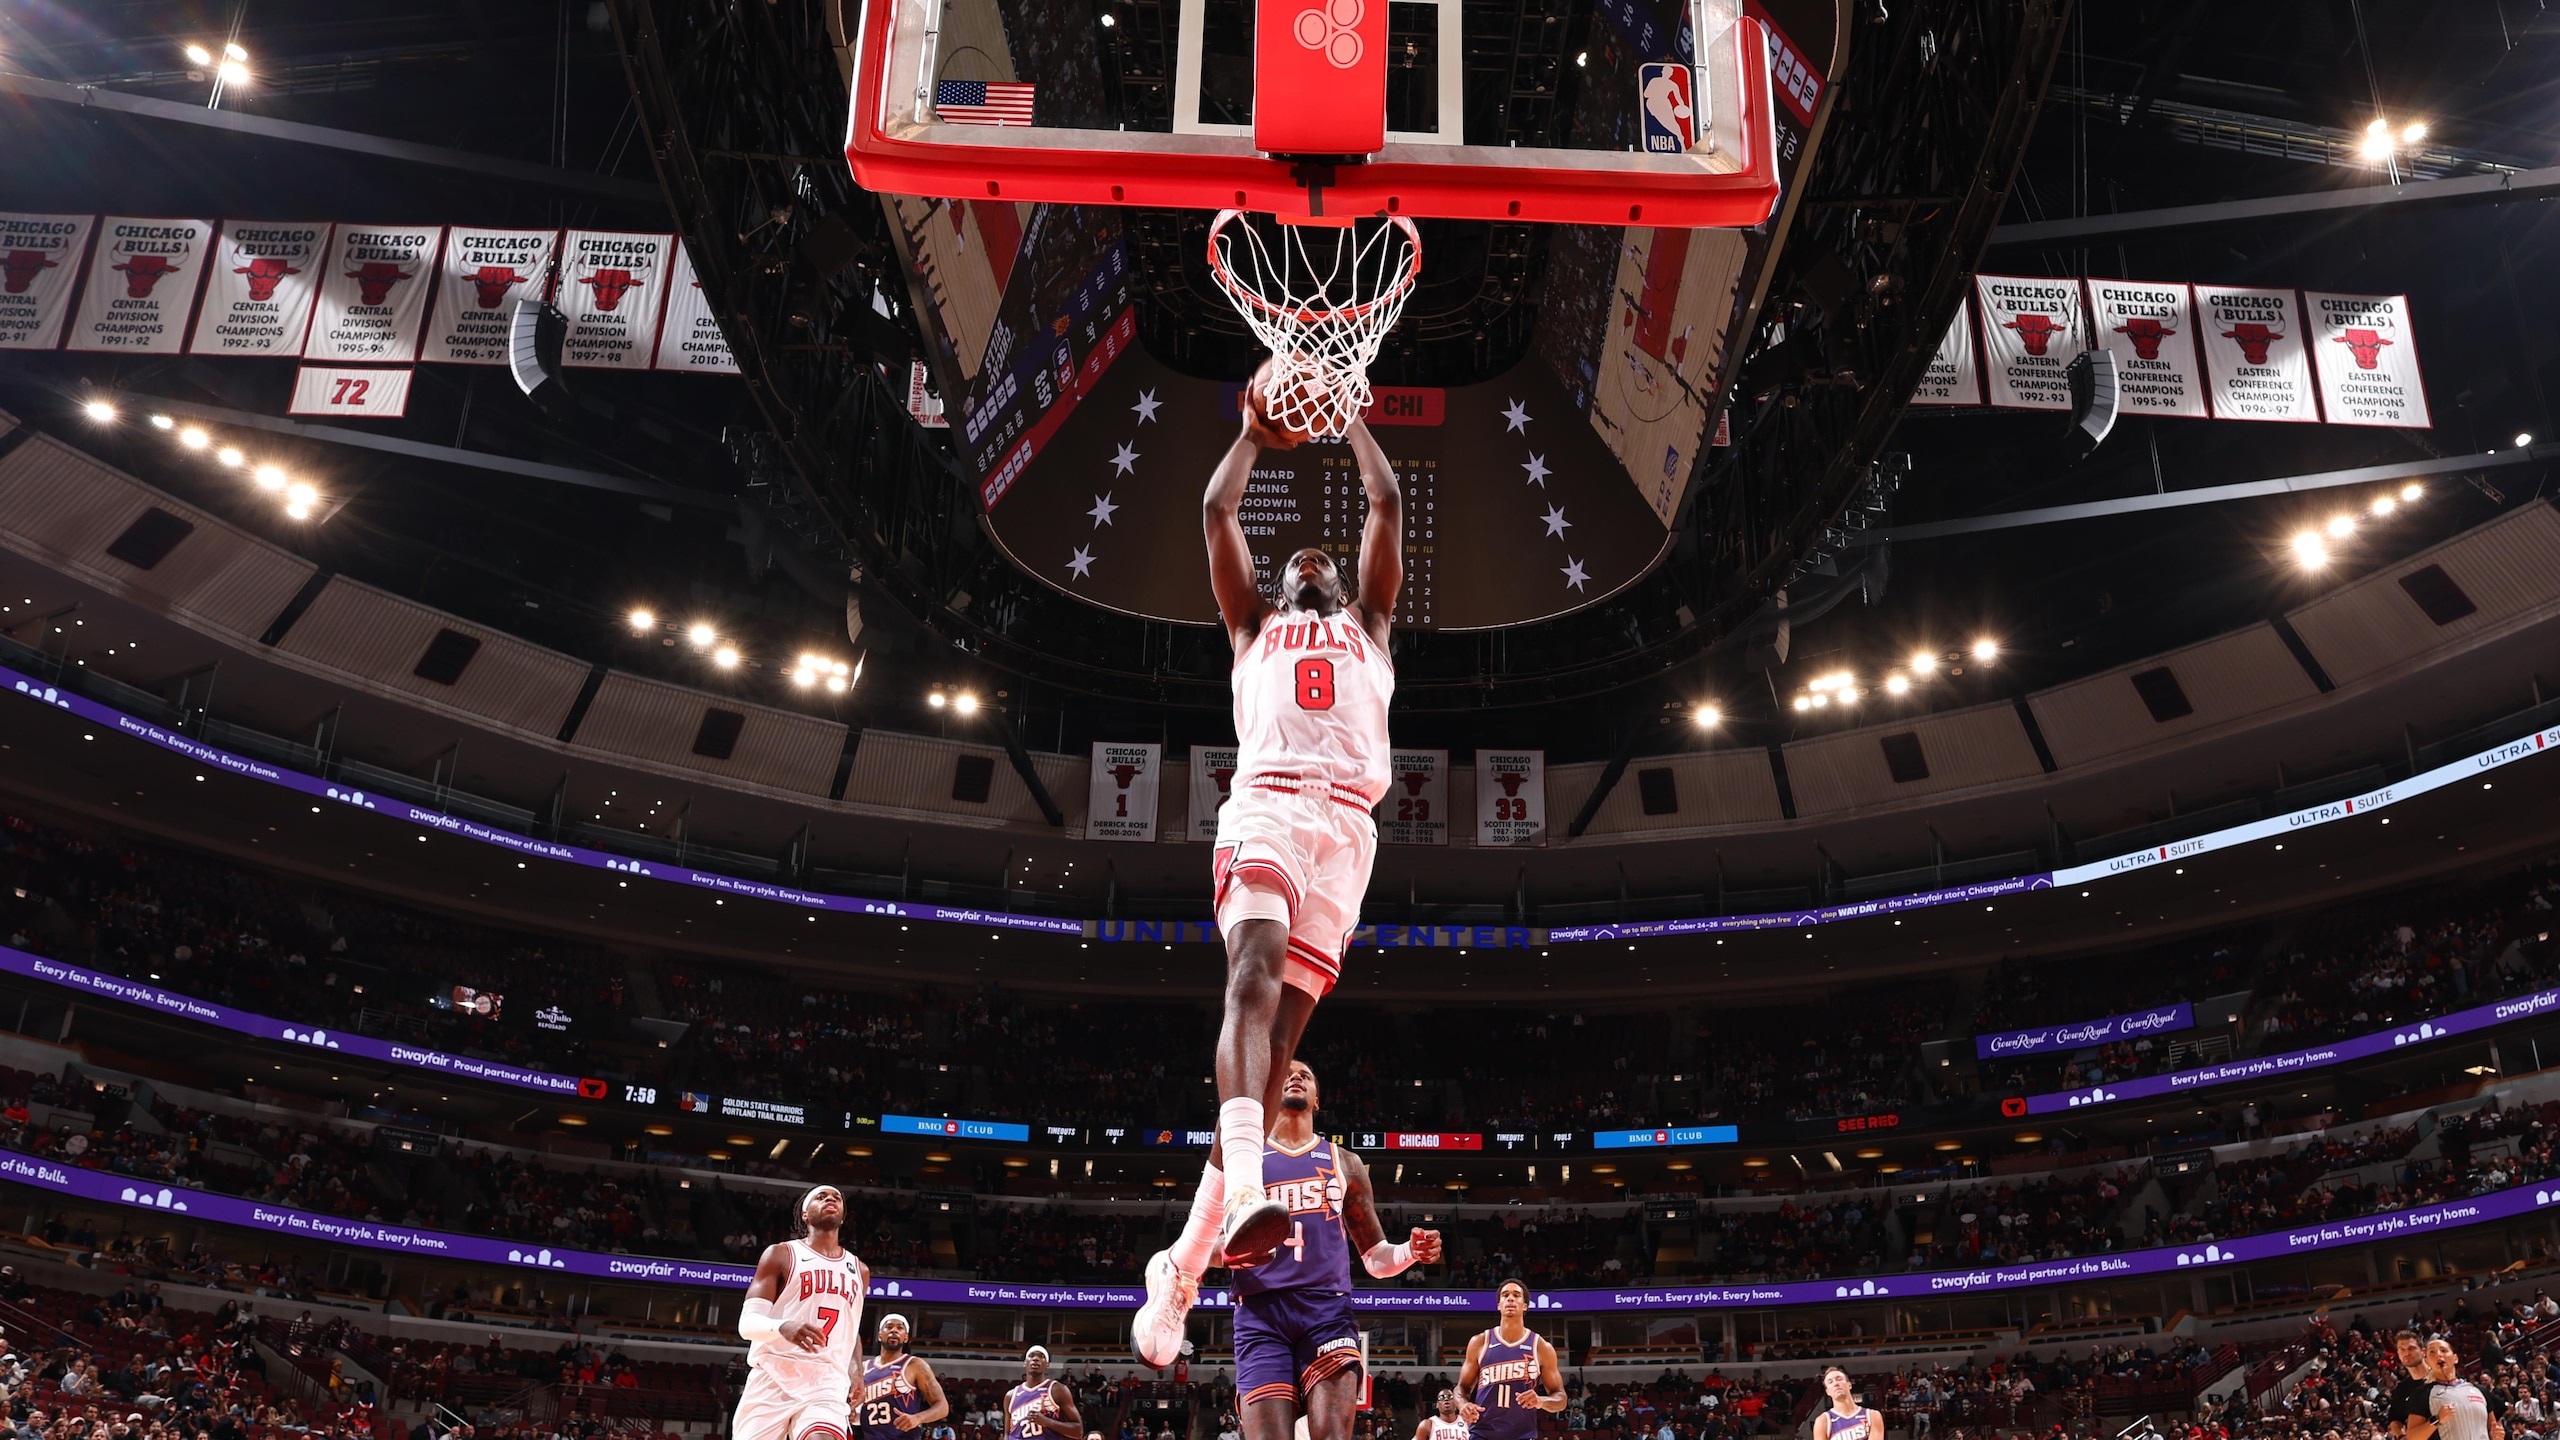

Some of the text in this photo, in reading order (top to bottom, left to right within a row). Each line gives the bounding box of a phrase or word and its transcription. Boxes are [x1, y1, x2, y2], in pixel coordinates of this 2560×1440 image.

[1651, 135, 1676, 151] NBA
[115, 225, 196, 239] CHICAGO
[235, 229, 315, 242] CHICAGO
[123, 240, 181, 253] BULLS
[245, 244, 302, 256] BULLS
[579, 240, 656, 254] CHICAGO
[589, 254, 644, 267] BULLS
[112, 299, 159, 309] CENTRAL
[233, 302, 279, 312] CENTRAL
[2210, 296, 2283, 309] CHICAGO
[2321, 299, 2393, 314] CHICAGO
[106, 312, 158, 321] DIVISION
[228, 314, 278, 324] DIVISION
[580, 314, 626, 324] CENTRAL
[2223, 309, 2275, 321] BULLS
[2334, 314, 2386, 327] BULLS
[94, 323, 163, 334] CHAMPIONS
[216, 325, 283, 336] CHAMPIONS
[575, 326, 626, 336] DIVISION
[566, 338, 632, 350] CHAMPIONS
[2236, 367, 2280, 376] EASTERN
[2349, 373, 2391, 382] EASTERN
[2229, 379, 2293, 390] CONFERENCE
[2341, 384, 2404, 395] CONFERENCE
[331, 379, 370, 405] 72
[2232, 391, 2294, 401] CHAMPIONS
[1384, 395, 1422, 417] CHI
[2343, 397, 2405, 407] CHAMPIONS
[1322, 458, 1334, 466] PTS
[1325, 472, 1331, 480] 2
[1325, 500, 1330, 508] 5
[1342, 500, 1347, 509] 3
[1324, 514, 1330, 522] 8
[1324, 528, 1330, 536] 6
[1261, 621, 1365, 663] BULLS
[1295, 658, 1335, 711] 8
[120, 717, 279, 779] Every fan. Every style. Every home.
[1105, 748, 1147, 756] CHICAGO
[1490, 756, 1531, 764] CHICAGO
[1116, 794, 1128, 817] 1
[1496, 798, 1527, 821] 33
[2290, 791, 2394, 827] ULTRA SUITE
[1093, 820, 1126, 828] DERRICK
[1514, 821, 1539, 829] PIPPEN
[418, 810, 461, 829] wayfair
[464, 824, 490, 838] Proud
[490, 833, 523, 847] partner
[534, 844, 548, 853] the
[550, 847, 573, 858] Bulls.
[1099, 829, 1141, 837] 2008-2016
[1556, 929, 1589, 939] wayfair
[1722, 919, 1758, 929] everything
[1759, 917, 1776, 925] ships
[1838, 906, 1858, 917] WAY
[1859, 903, 1877, 914] DAY
[1888, 900, 1902, 908] the
[1910, 893, 1943, 906] wayfair
[1944, 891, 1966, 899] store
[1968, 879, 2024, 896] Chicagoland
[1099, 920, 1222, 943] UNIT
[33, 961, 219, 1019] Every fan. Every style. Every home.
[400, 1048, 656, 1104] wayfair Proud partner of the Bulls. 7:58
[723, 1098, 803, 1115] GOLDEN STATE WARRIORS
[722, 1106, 804, 1124] PORTLAND TRAIL BLAZERS
[918, 1122, 993, 1134] BMO CLUB
[1047, 1126, 1124, 1137] TIMEOUTS FOULS
[1837, 1118, 1866, 1132] SEE
[1363, 1134, 1440, 1148] 33 CHICAGO
[1554, 1133, 1572, 1141] FOULS
[254, 1208, 447, 1249] Every fan. Every style. Every home.
[622, 1261, 674, 1279] wayfair
[679, 1267, 711, 1280] Proud
[1940, 1259, 2130, 1289] wayfair Proud partner of the Bulls.
[800, 1270, 859, 1309] BULLS
[814, 1306, 839, 1346] 7
[1482, 1362, 1525, 1386] SUNS
[1498, 1384, 1511, 1409] 11
[867, 1401, 892, 1426] 23
[1020, 1419, 1043, 1439] 20
